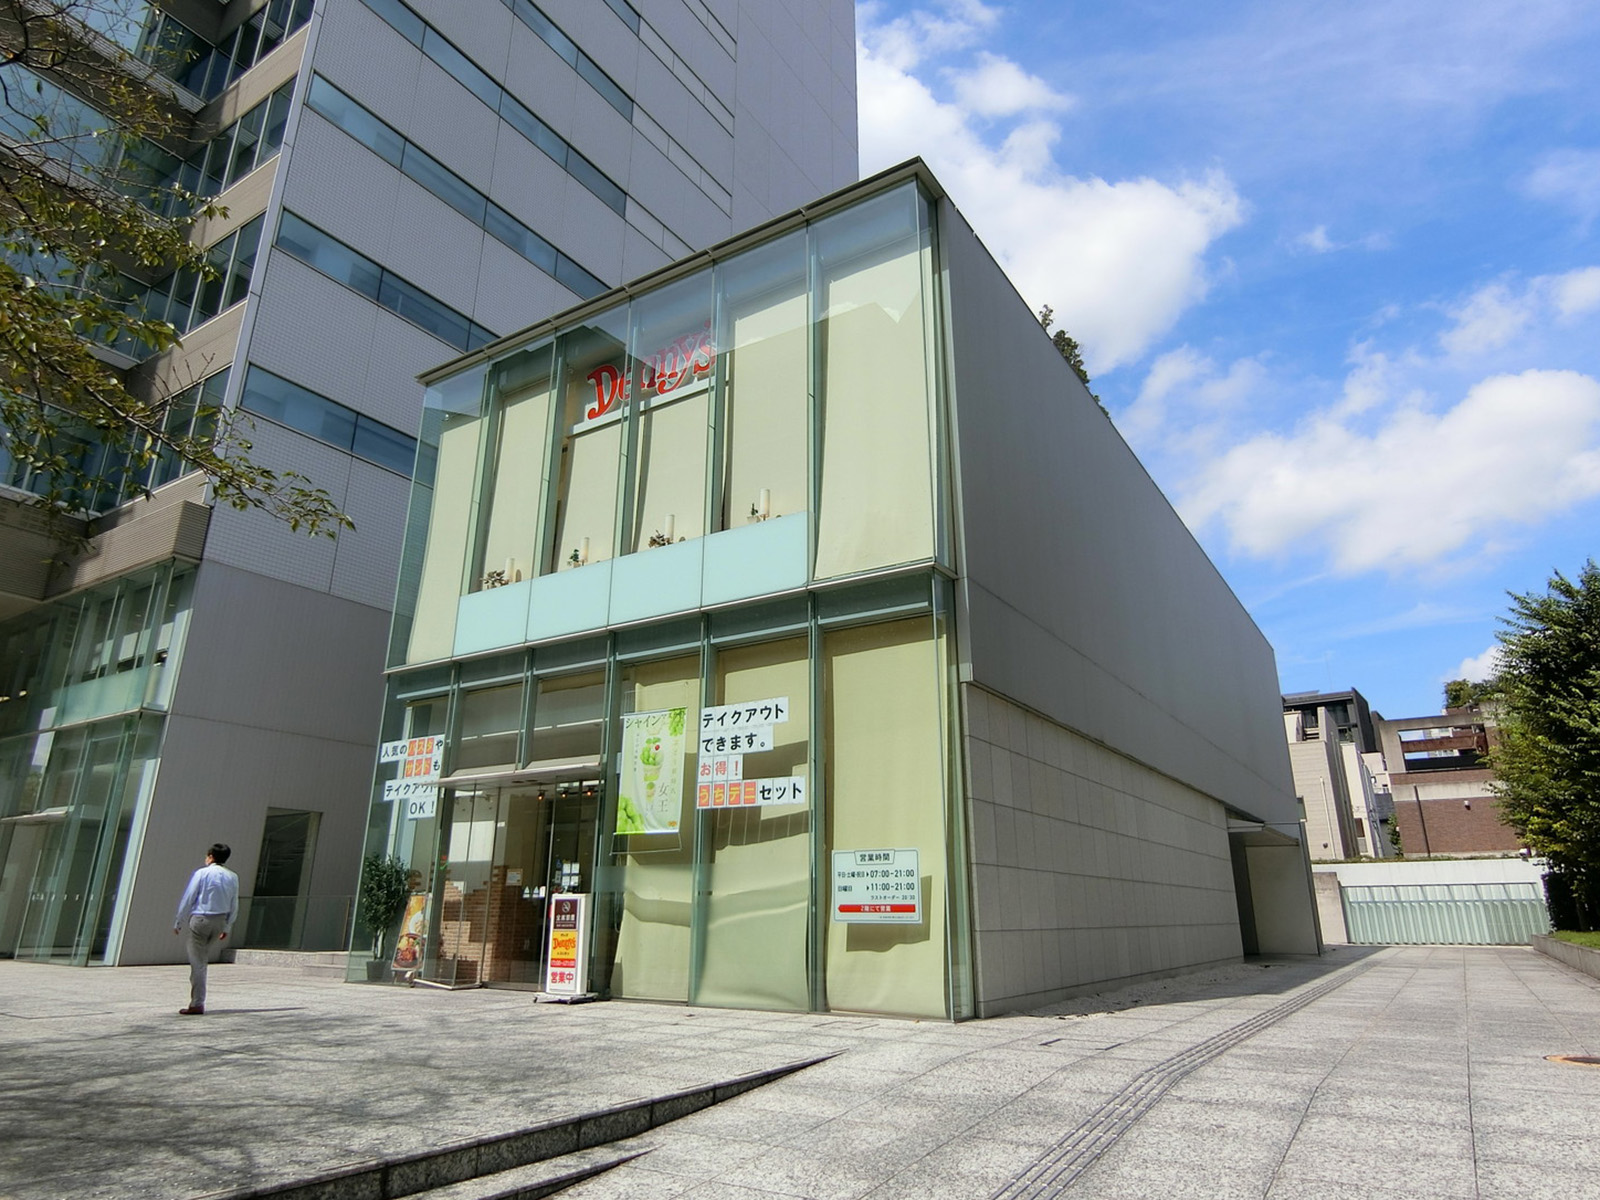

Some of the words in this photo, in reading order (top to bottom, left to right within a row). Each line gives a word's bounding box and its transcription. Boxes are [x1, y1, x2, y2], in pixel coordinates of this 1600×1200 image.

[587, 319, 716, 420] Denny's
[702, 703, 784, 728] テイクアウト
[382, 739, 444, 758] 人気のパスタや
[702, 732, 767, 752] できます。
[405, 760, 440, 777] サンドも
[700, 760, 739, 776] お得！
[699, 782, 802, 804] うちデニセット
[409, 801, 435, 815] OK！
[859, 853, 890, 862] 営業時間
[550, 971, 575, 985] 営業中
